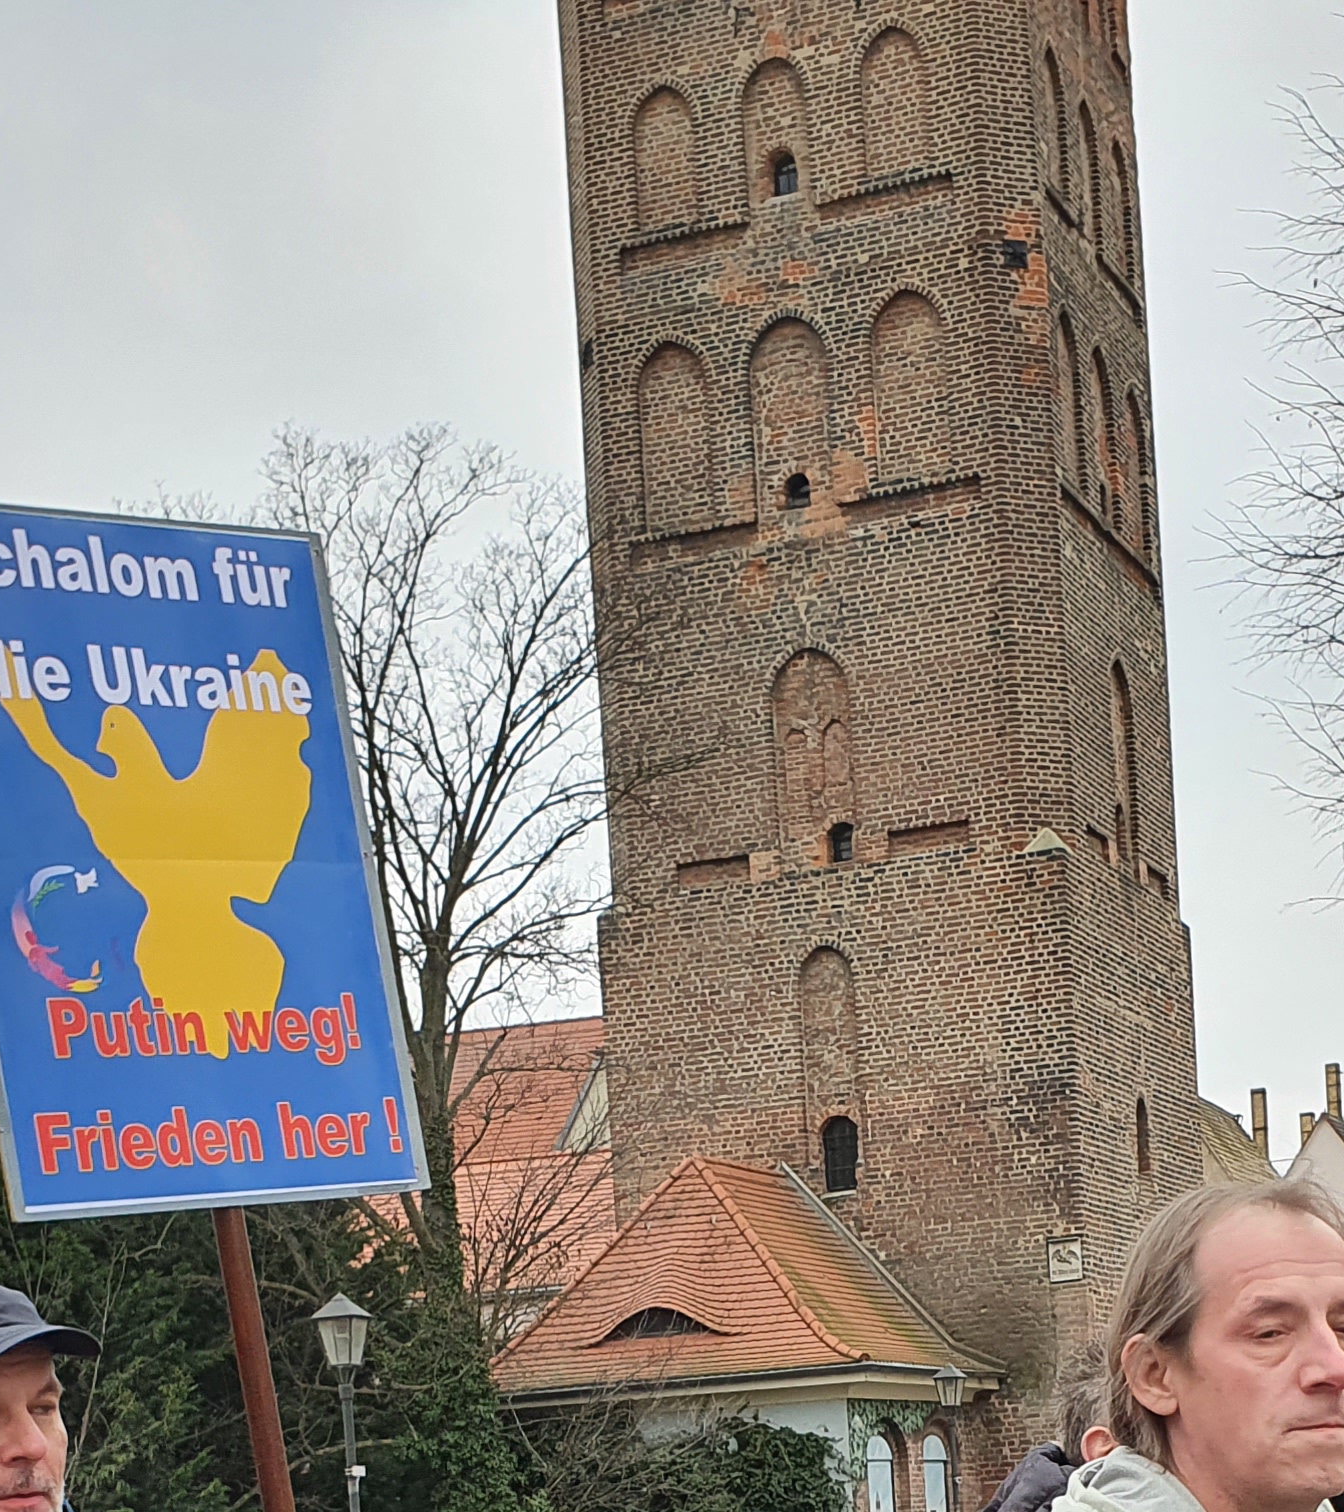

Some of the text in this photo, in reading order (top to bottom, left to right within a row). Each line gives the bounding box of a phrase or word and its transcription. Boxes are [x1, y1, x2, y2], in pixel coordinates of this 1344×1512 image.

[212, 546, 292, 608] für
[86, 643, 313, 716] Ukraine
[47, 992, 362, 1067] Putin weg!
[33, 1096, 404, 1175] Frieden her !
